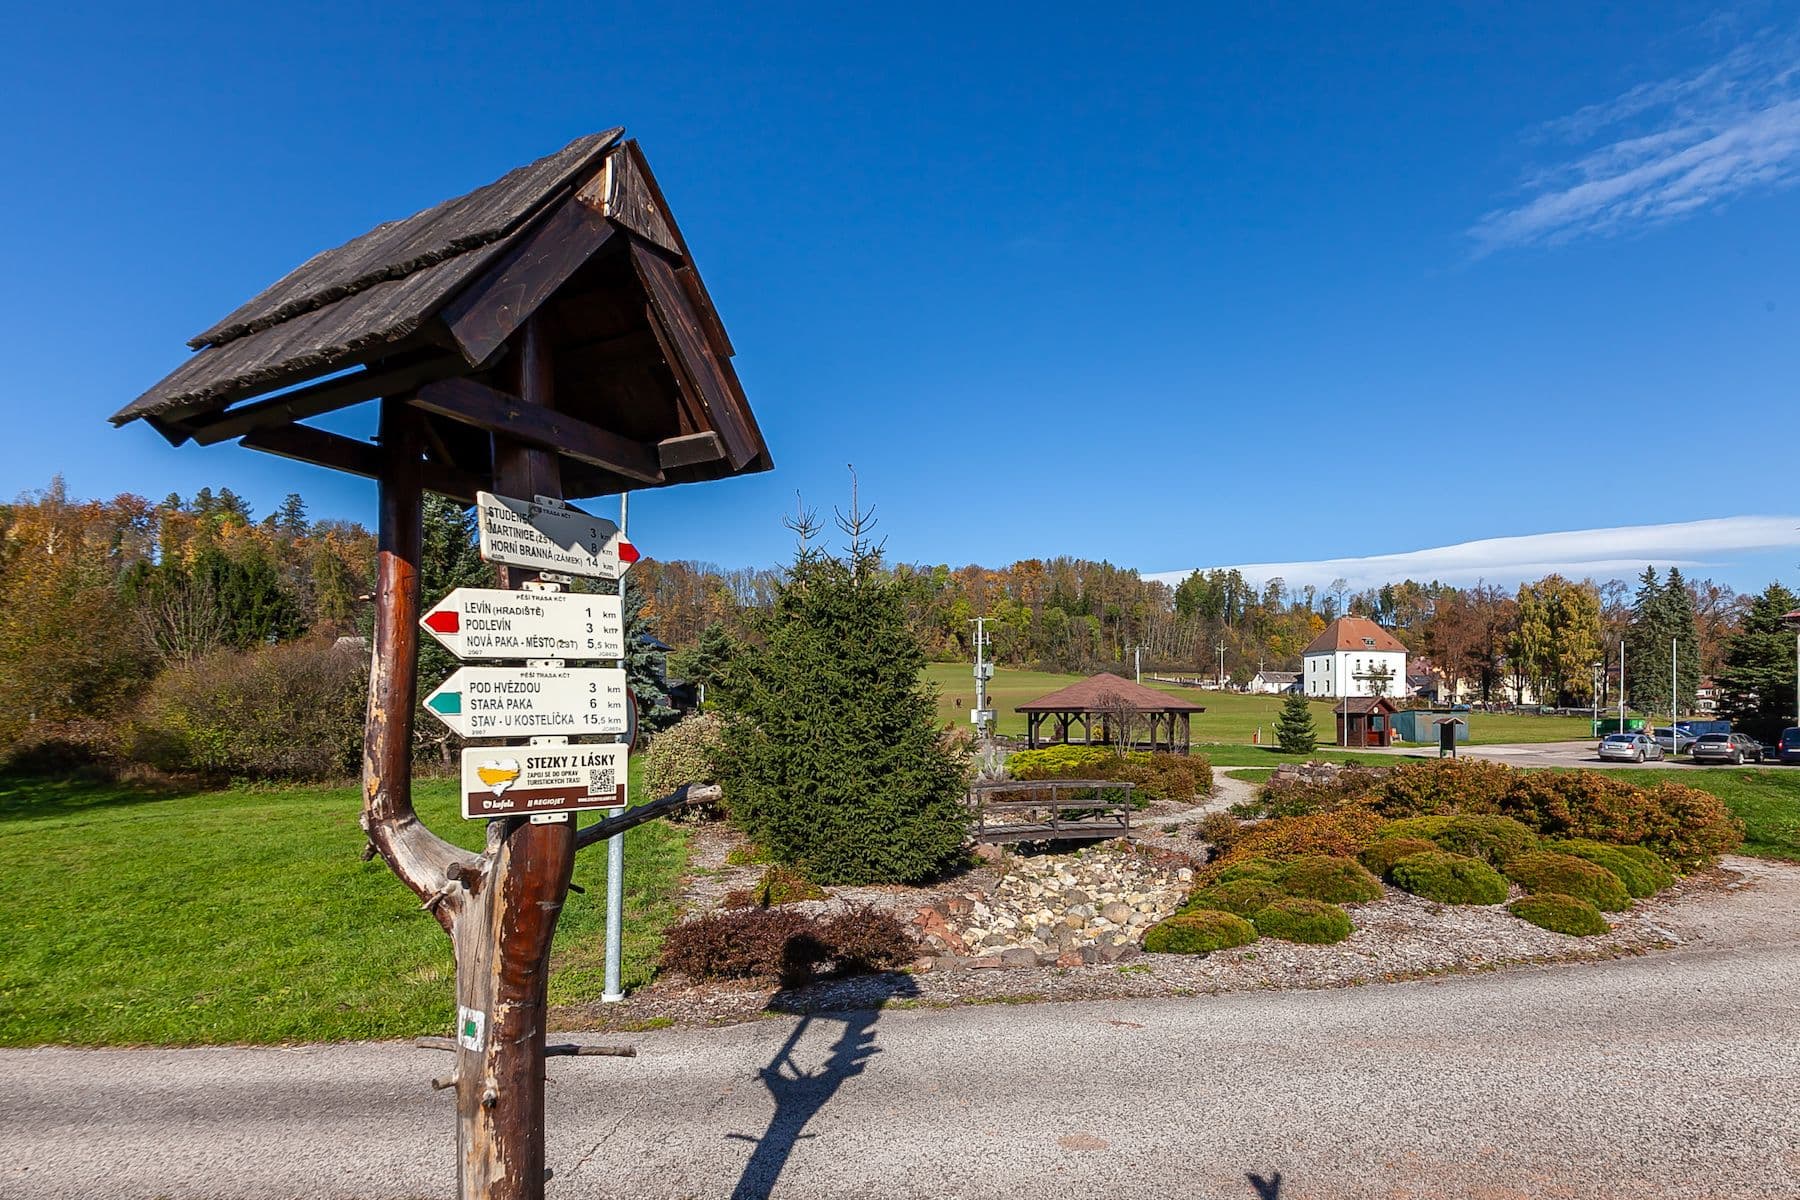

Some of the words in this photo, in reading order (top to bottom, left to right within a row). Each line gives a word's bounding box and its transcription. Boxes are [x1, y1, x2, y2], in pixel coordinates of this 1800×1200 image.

[590, 528, 597, 538] 3
[491, 539, 518, 554] HORNÍ
[520, 544, 553, 560] BRANNÁ
[554, 553, 583, 567] (ZÁMEK)
[586, 557, 599, 567] 14
[603, 562, 614, 570] km
[602, 548, 613, 556] km
[465, 600, 492, 614] LEVÍN
[493, 606, 545, 617] (HRADIŠTĚ)
[585, 608, 592, 618] 1
[603, 611, 617, 619] km
[466, 617, 511, 631] PODLEVÍN
[586, 623, 594, 633] 3
[603, 626, 618, 634] km
[467, 633, 493, 647] NOVÁ
[495, 636, 519, 648] PAKA
[526, 635, 555, 648] MĚSTO
[605, 640, 618, 650] km
[469, 682, 492, 693] POD
[494, 680, 541, 693] HVĚZDOU
[589, 683, 597, 693] 3
[607, 685, 621, 693] km
[470, 696, 504, 710] STARÁ
[506, 698, 533, 710] PAKA
[590, 698, 597, 709] 6
[608, 700, 621, 709] km
[471, 714, 496, 727] STAV
[505, 714, 513, 726] U
[515, 711, 575, 726] KOSTELÍČKA
[608, 716, 621, 725] km
[527, 756, 568, 769] STEZKY
[572, 756, 578, 767] Z
[581, 752, 615, 767] LÁSKY
